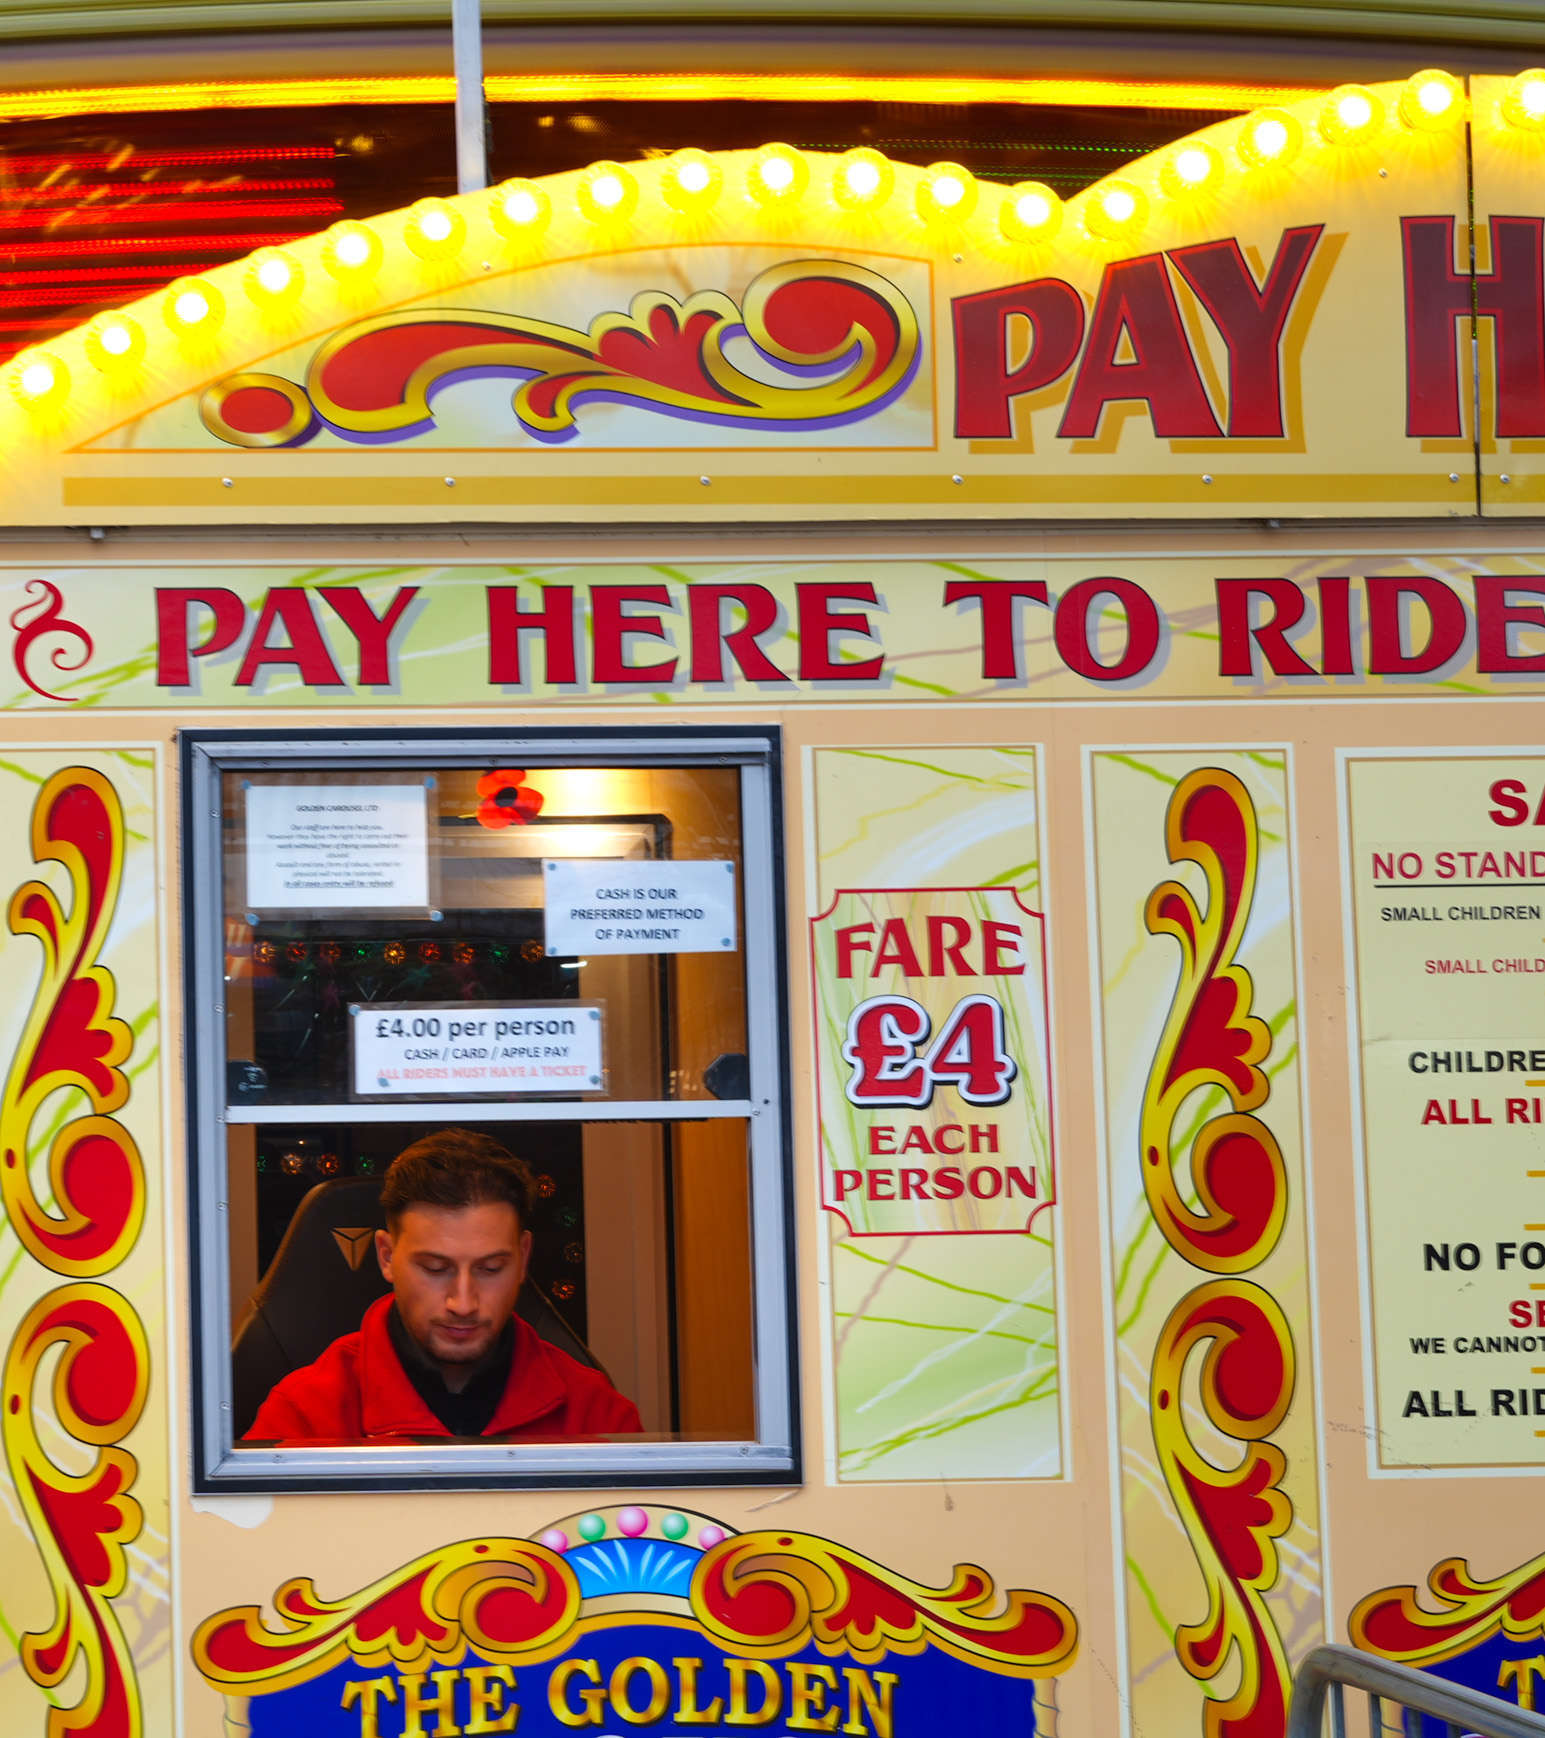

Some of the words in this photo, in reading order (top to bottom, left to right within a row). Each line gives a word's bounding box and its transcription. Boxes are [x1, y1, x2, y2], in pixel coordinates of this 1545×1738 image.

[951, 223, 1326, 440] PAY
[154, 586, 422, 687] PAY
[486, 582, 885, 684] HERE
[943, 576, 1160, 681] TO
[1215, 575, 1545, 678] RIDE
[1371, 852, 1424, 880] NO
[596, 888, 630, 900] CASH
[633, 888, 645, 900] IS
[647, 888, 678, 900] OUR
[570, 908, 642, 920] PREFERRED
[646, 908, 705, 920] METHOD
[1380, 906, 1444, 922] SMALL
[1447, 905, 1542, 920] CHILDREN
[595, 928, 613, 940] OF
[616, 928, 681, 940] PAYMENT
[834, 915, 1028, 979] FARE
[1424, 959, 1488, 974] SMALL
[376, 1018, 441, 1038] £4.00
[448, 1019, 487, 1041] per
[494, 1019, 576, 1041] person
[404, 1048, 438, 1060] CASH
[452, 1048, 488, 1060] CARD
[500, 1047, 542, 1059] APPLE
[544, 1046, 571, 1058] PAY
[842, 993, 1018, 1110] £4
[377, 1069, 401, 1080] ALL
[402, 1067, 449, 1080] RIDERS
[452, 1067, 487, 1079] MUST
[491, 1066, 527, 1078] HAVE
[529, 1066, 539, 1078] A
[542, 1065, 587, 1077] TICKET
[1421, 1099, 1493, 1125] ALL
[868, 1123, 1000, 1155] EACH
[832, 1166, 1037, 1202] PERSON
[1423, 1243, 1481, 1271] NO
[1409, 1337, 1446, 1354] WE
[1402, 1389, 1476, 1418] ALL
[340, 1663, 520, 1738] THE
[547, 1656, 899, 1738] GOLDEN
